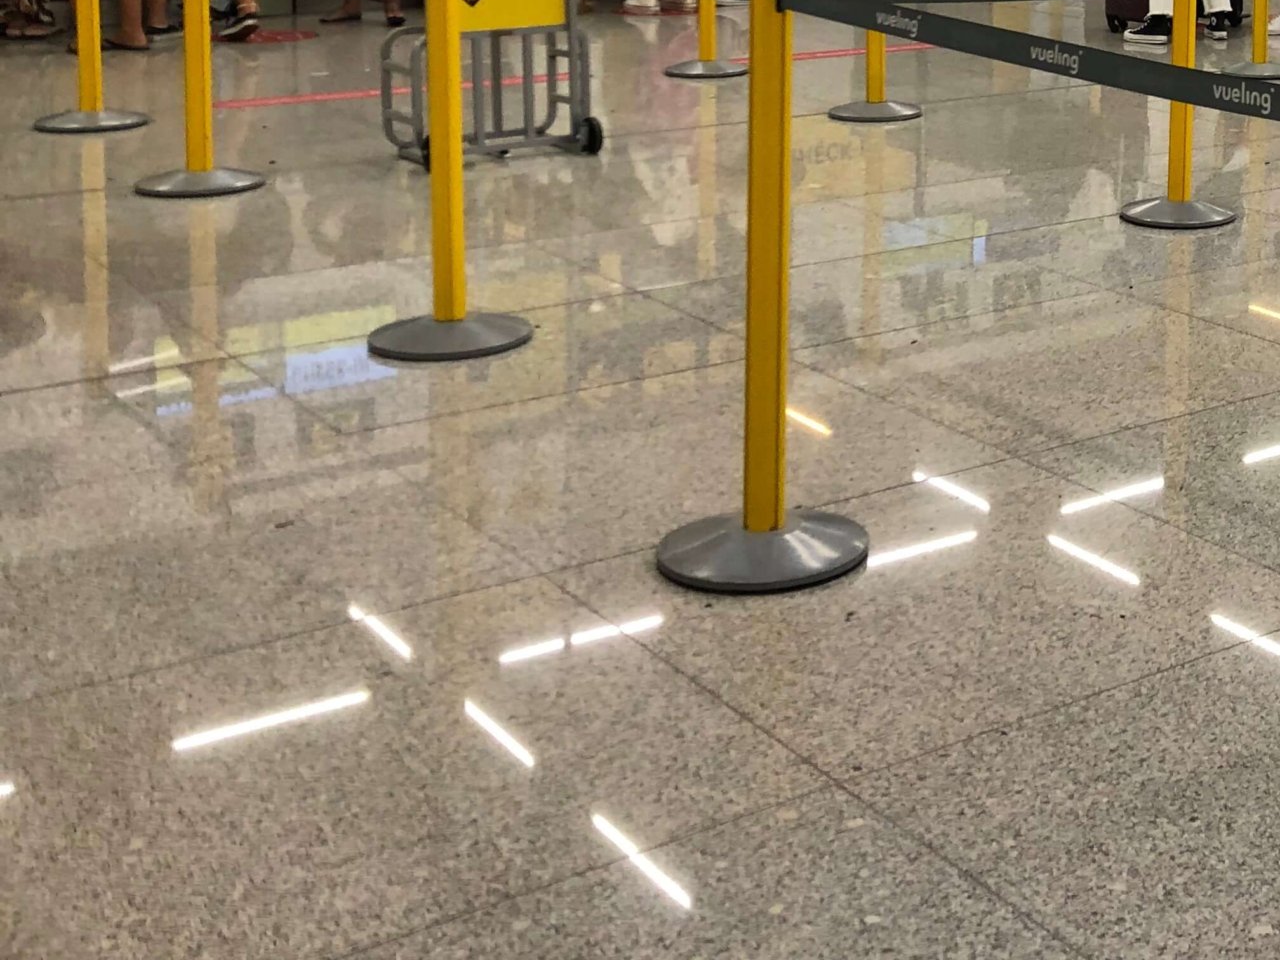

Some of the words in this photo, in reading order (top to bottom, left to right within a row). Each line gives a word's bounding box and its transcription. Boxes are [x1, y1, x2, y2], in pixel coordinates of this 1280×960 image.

[876, 11, 922, 38] vueling
[1030, 44, 1083, 75] vueling
[1213, 82, 1275, 115] vueling
